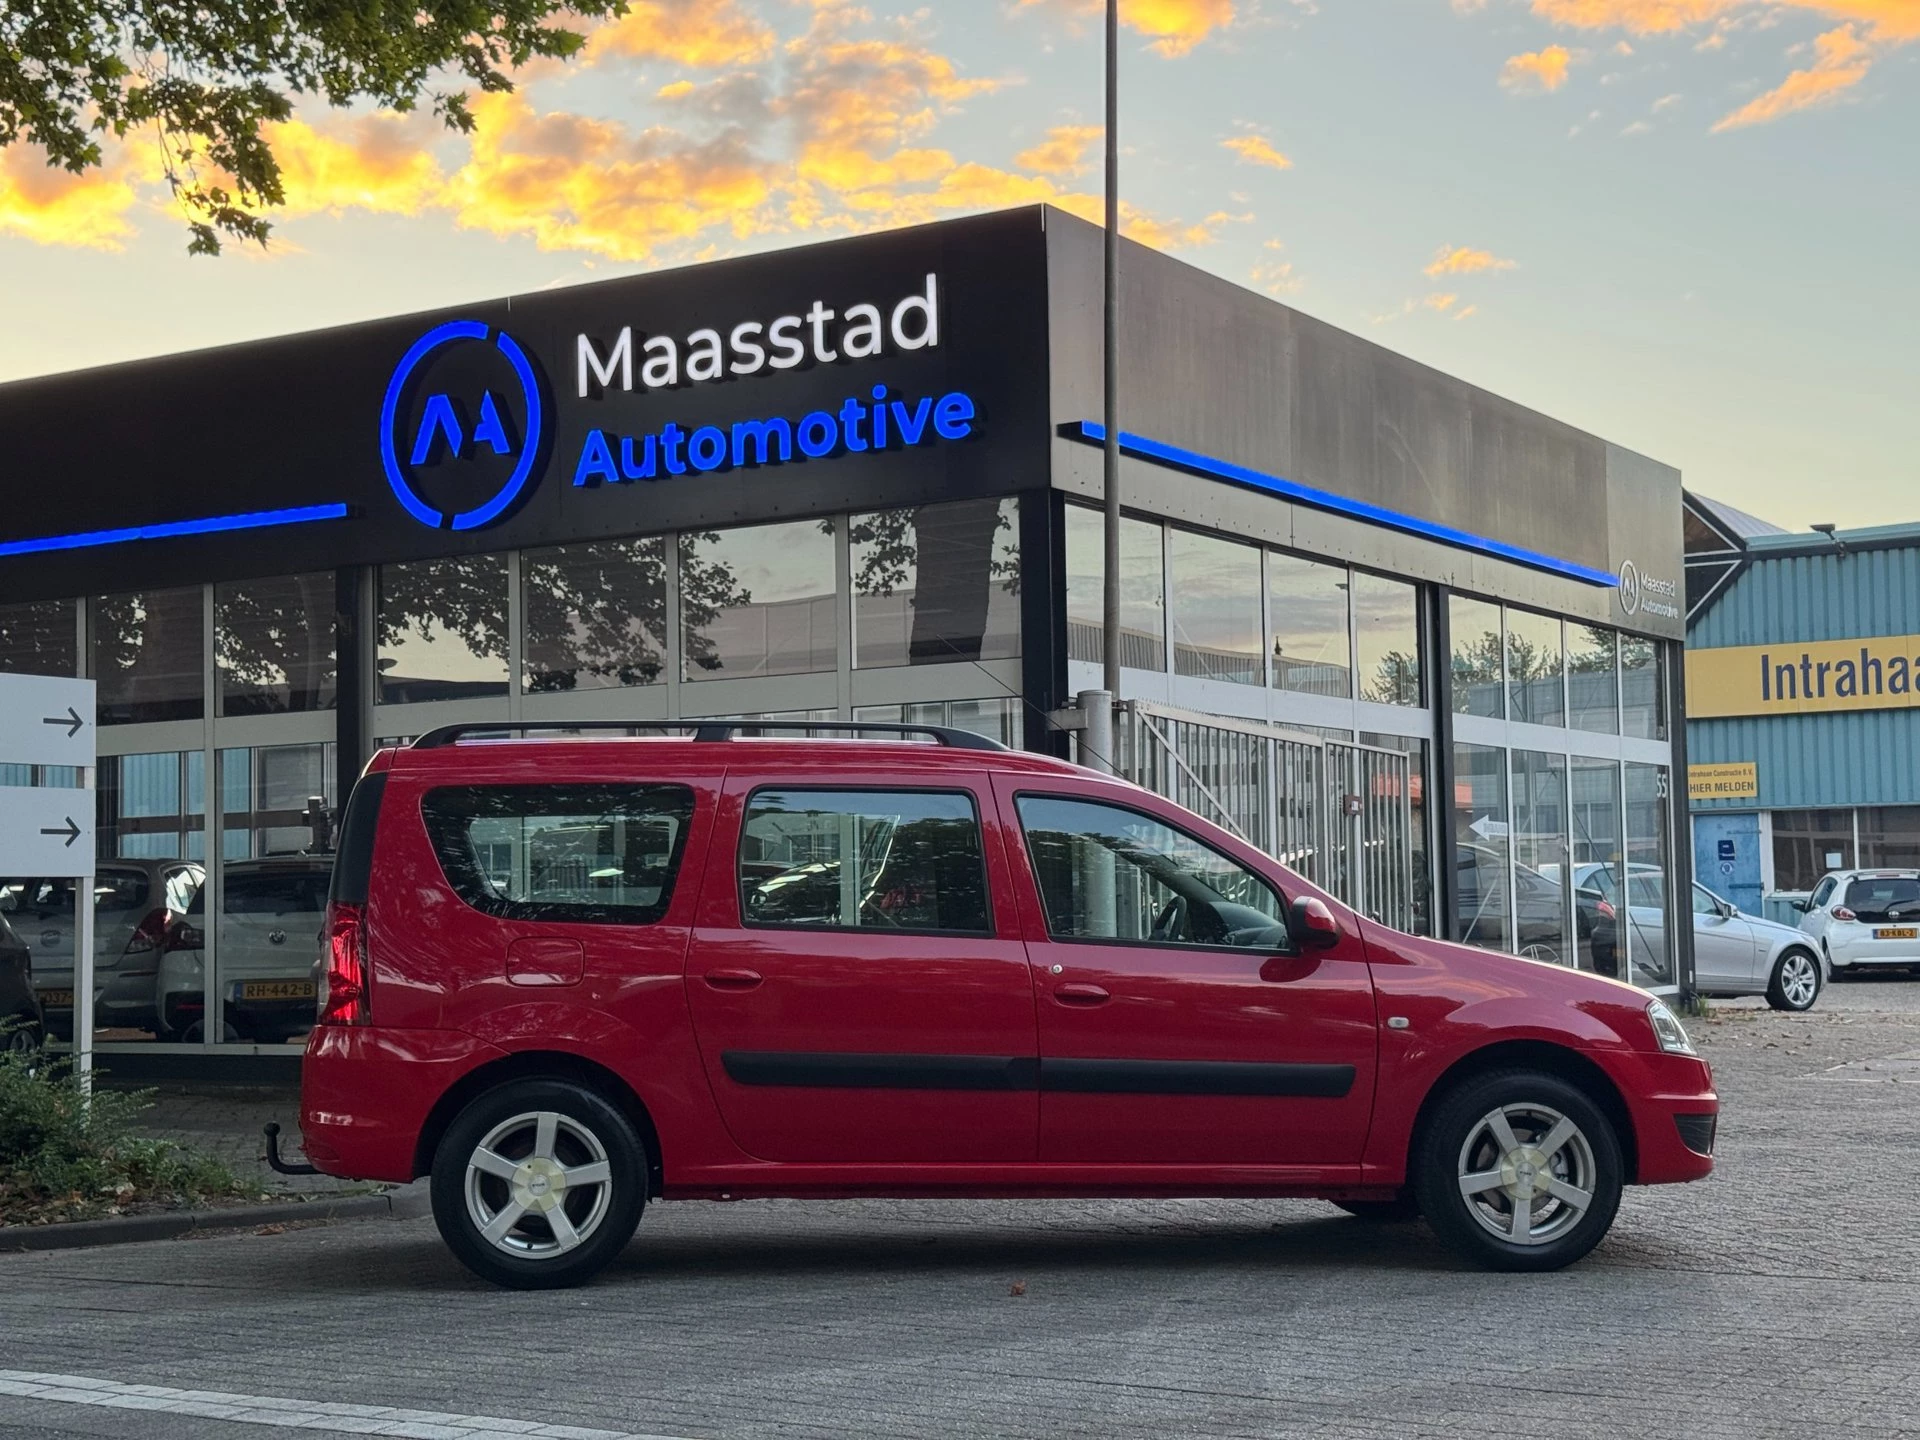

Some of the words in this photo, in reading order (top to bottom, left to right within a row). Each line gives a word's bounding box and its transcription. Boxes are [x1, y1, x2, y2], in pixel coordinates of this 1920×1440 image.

[576, 272, 941, 398] Maasstad
[573, 385, 975, 487] Automotive
[1640, 571, 1675, 597] Maasstad
[1640, 596, 1678, 619] Automotive
[1657, 773, 1667, 798] 55
[1689, 783, 1712, 793] HIER
[1714, 781, 1754, 792] MELDEN
[246, 983, 313, 998] RH-442-B
